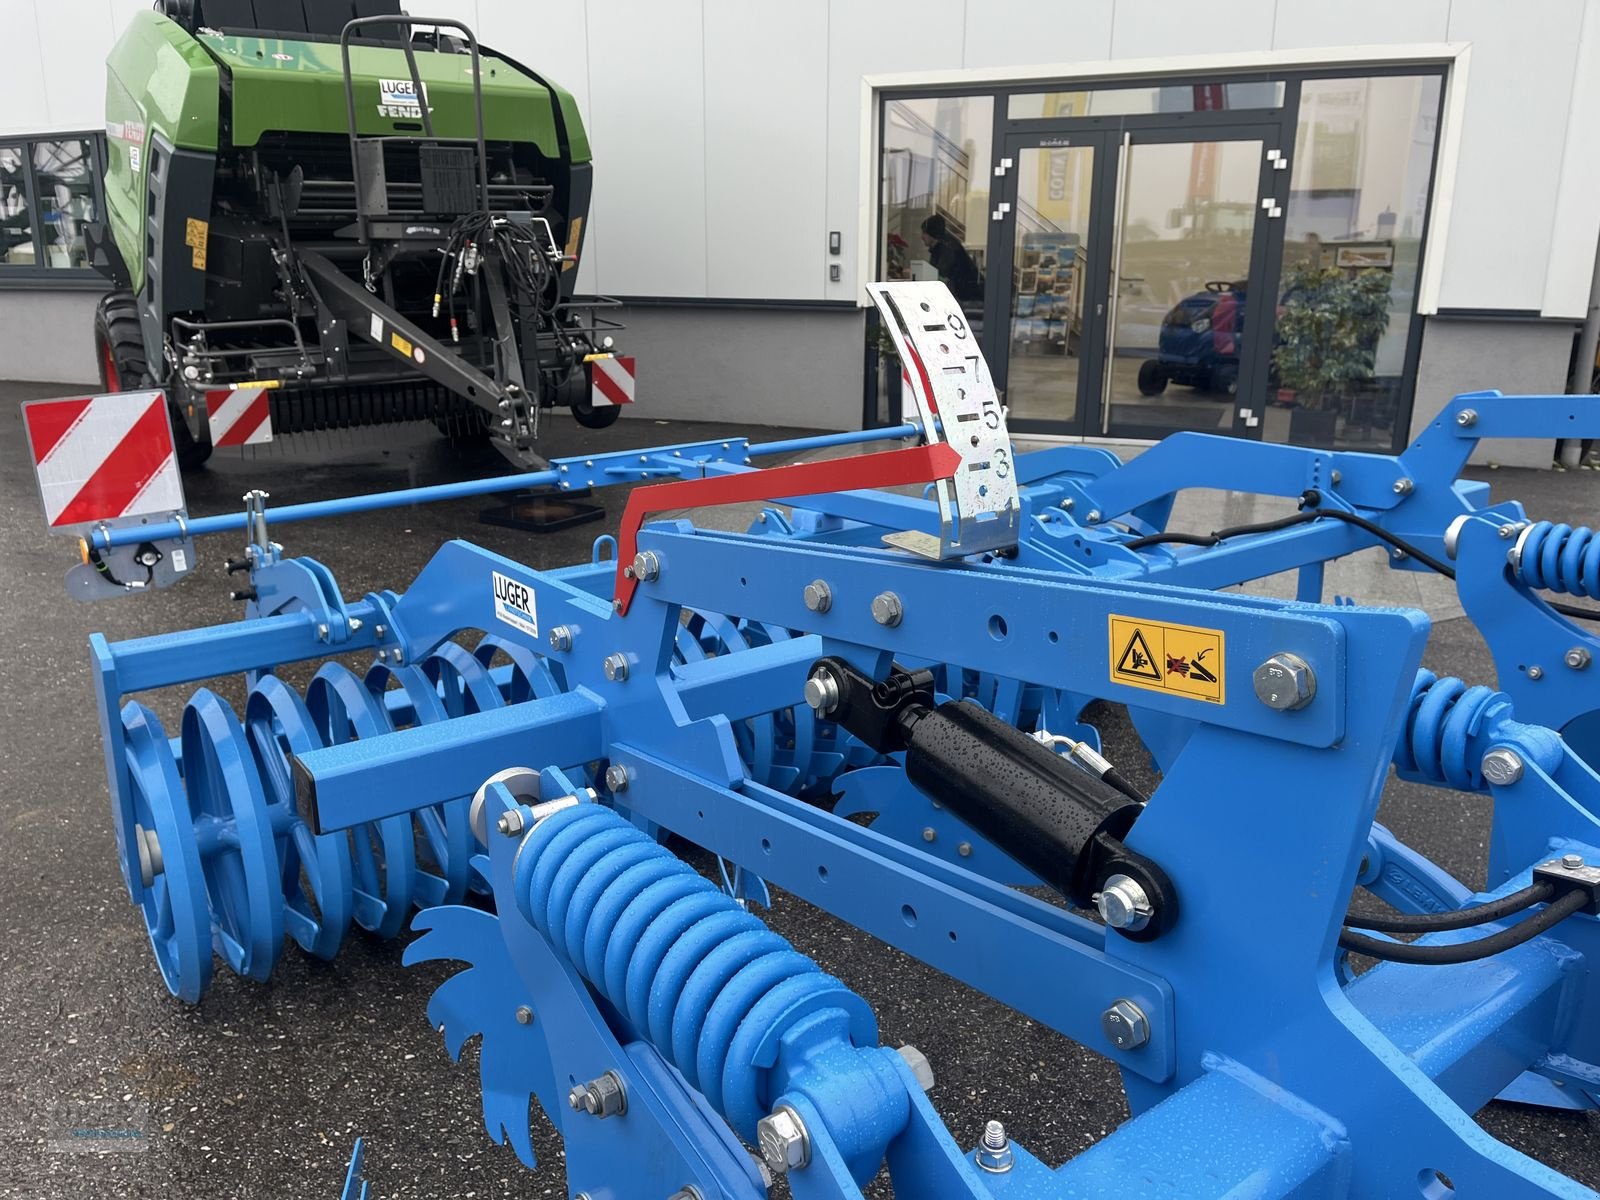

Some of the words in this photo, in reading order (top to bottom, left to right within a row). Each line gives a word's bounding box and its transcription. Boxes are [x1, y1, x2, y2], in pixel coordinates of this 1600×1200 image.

[947, 313, 967, 340] 9
[964, 355, 980, 384] 7
[982, 401, 1000, 430] 5
[993, 448, 1010, 479] 3
[494, 576, 530, 613] LUGER
